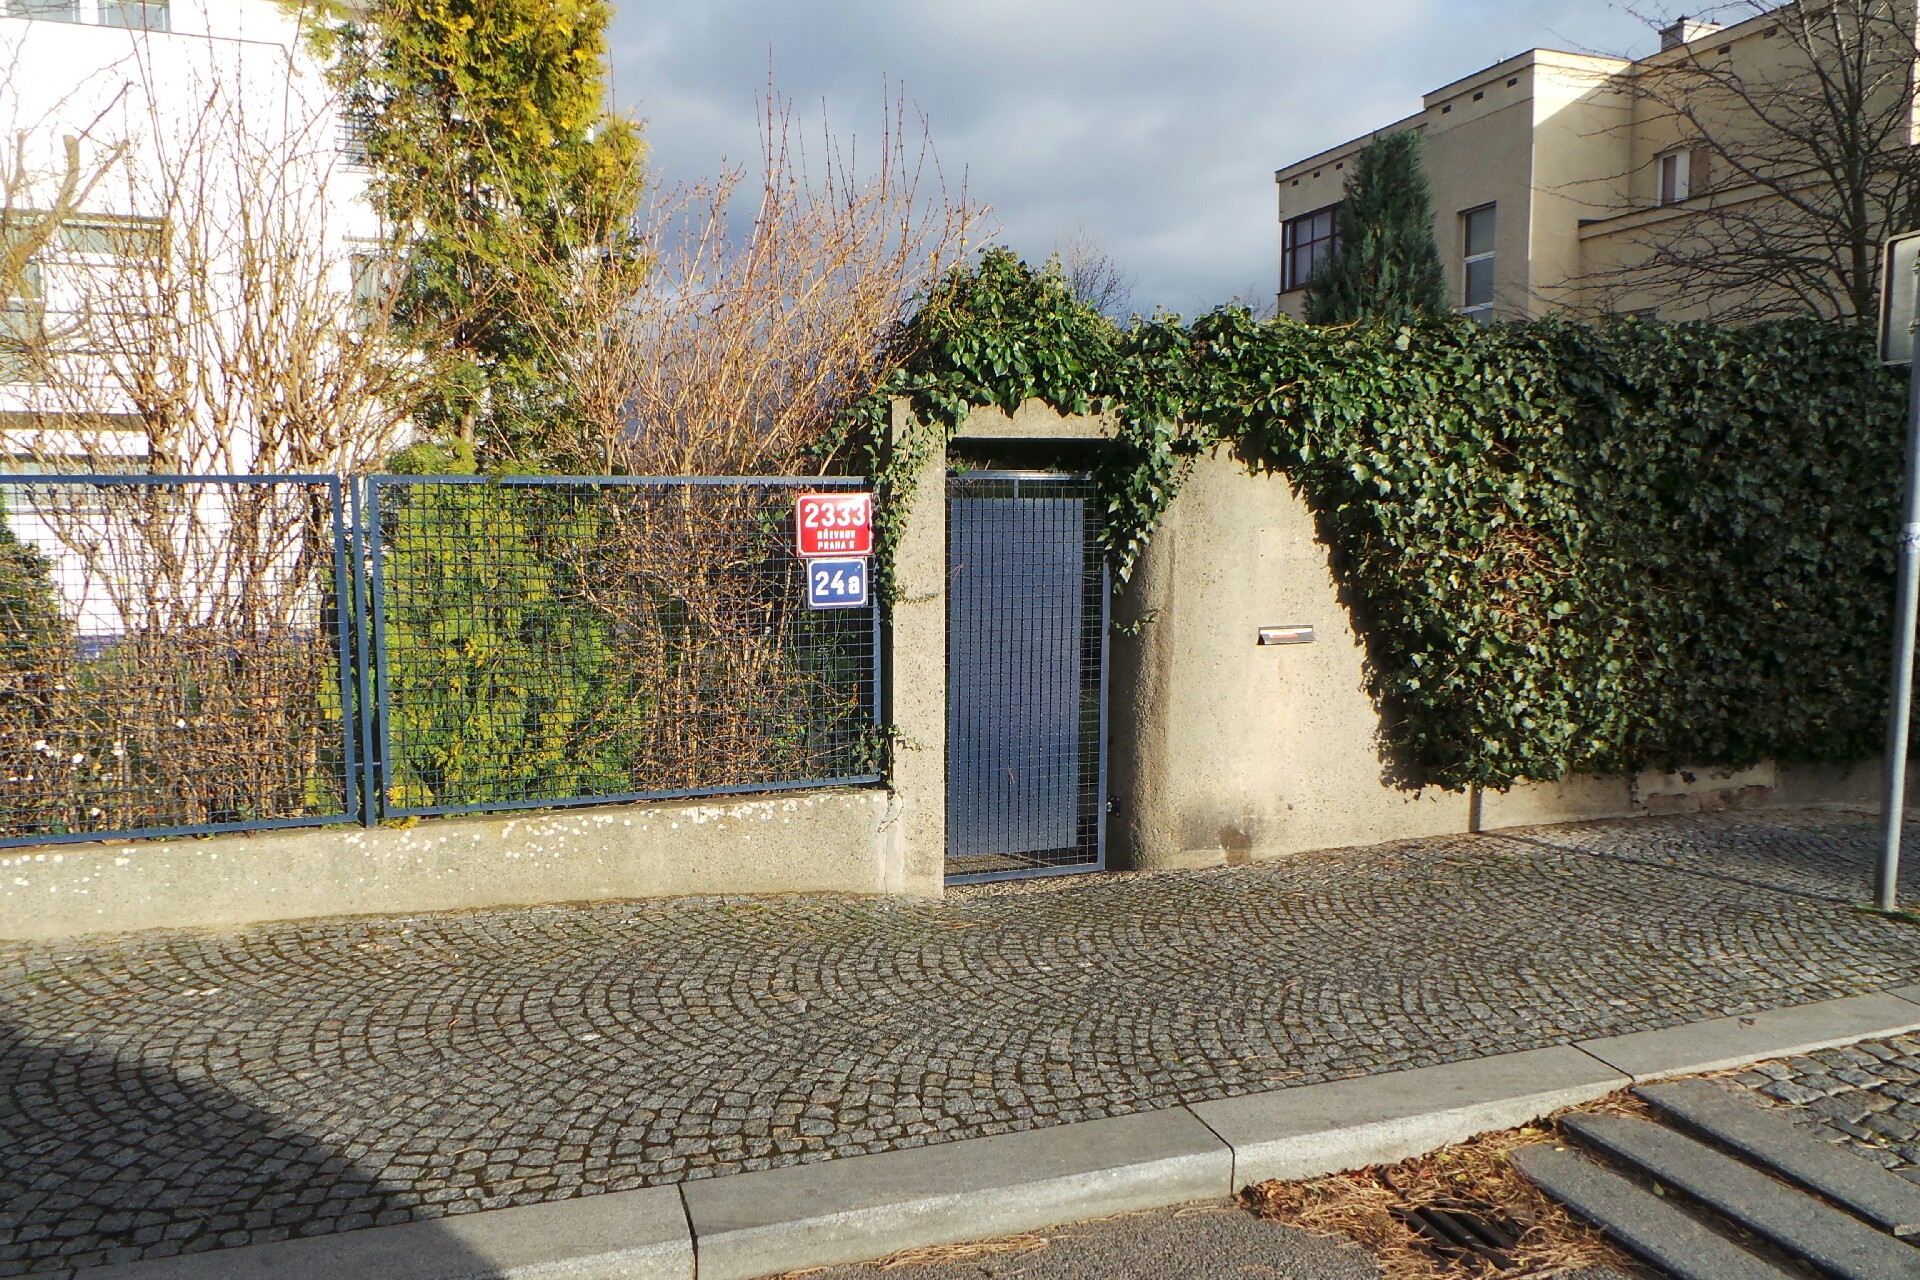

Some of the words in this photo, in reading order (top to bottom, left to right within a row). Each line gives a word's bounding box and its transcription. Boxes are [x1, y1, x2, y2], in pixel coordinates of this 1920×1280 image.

[805, 503, 866, 528] 2333
[817, 541, 846, 550] PRAHA
[815, 570, 860, 596] 24a
